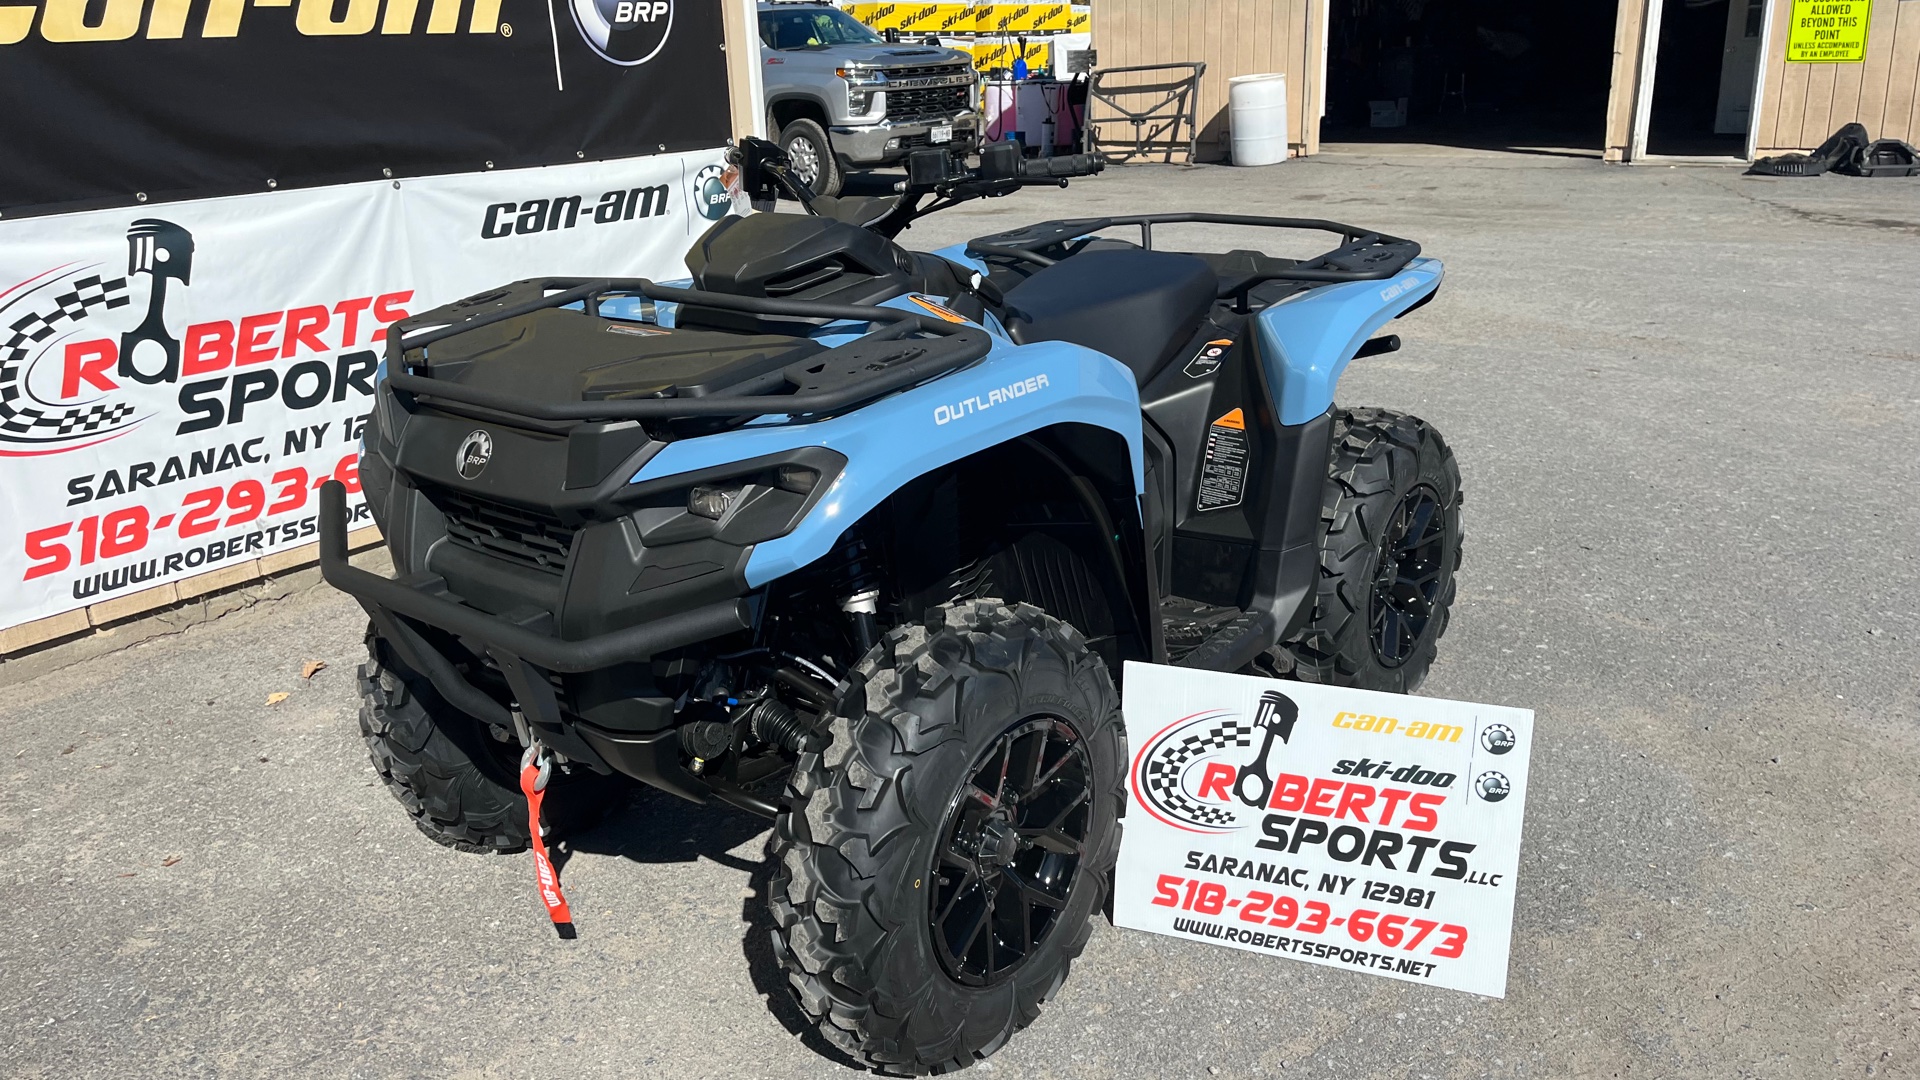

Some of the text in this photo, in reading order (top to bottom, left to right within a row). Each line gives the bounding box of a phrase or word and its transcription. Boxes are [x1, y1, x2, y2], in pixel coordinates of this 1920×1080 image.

[614, 1, 668, 24] BRP
[861, 4, 895, 27] ki-doo
[900, 4, 938, 30] ski-doo
[1033, 5, 1064, 29] ski-doo
[1801, 17, 1858, 28] BEYOND THIS
[1811, 5, 1851, 15] ALLOWED
[1814, 30, 1841, 40] POINT
[974, 45, 1007, 69] ski-doo
[888, 75, 971, 88] CHEVROLET
[481, 184, 669, 239] can-am
[1380, 276, 1420, 302] can-am
[60, 290, 415, 399] ROBERTS
[176, 350, 380, 436] SPOR
[934, 373, 1050, 426] OUTLANDER
[66, 436, 271, 507] SARANAC,
[283, 421, 332, 456] NY
[466, 454, 487, 466] BRP
[1332, 711, 1464, 743] can-am
[1493, 740, 1514, 749] BRP
[1332, 758, 1458, 788] ski-doo
[1197, 762, 1447, 832] ROBERTS
[1488, 787, 1509, 796] BRP
[535, 851, 562, 907] can-am
[1184, 850, 1437, 910] SARANAC, NY 12981
[1151, 873, 1469, 959] 518-293-6673
[1172, 917, 1438, 978] WWW.ROBERTSSPORTS.NET
